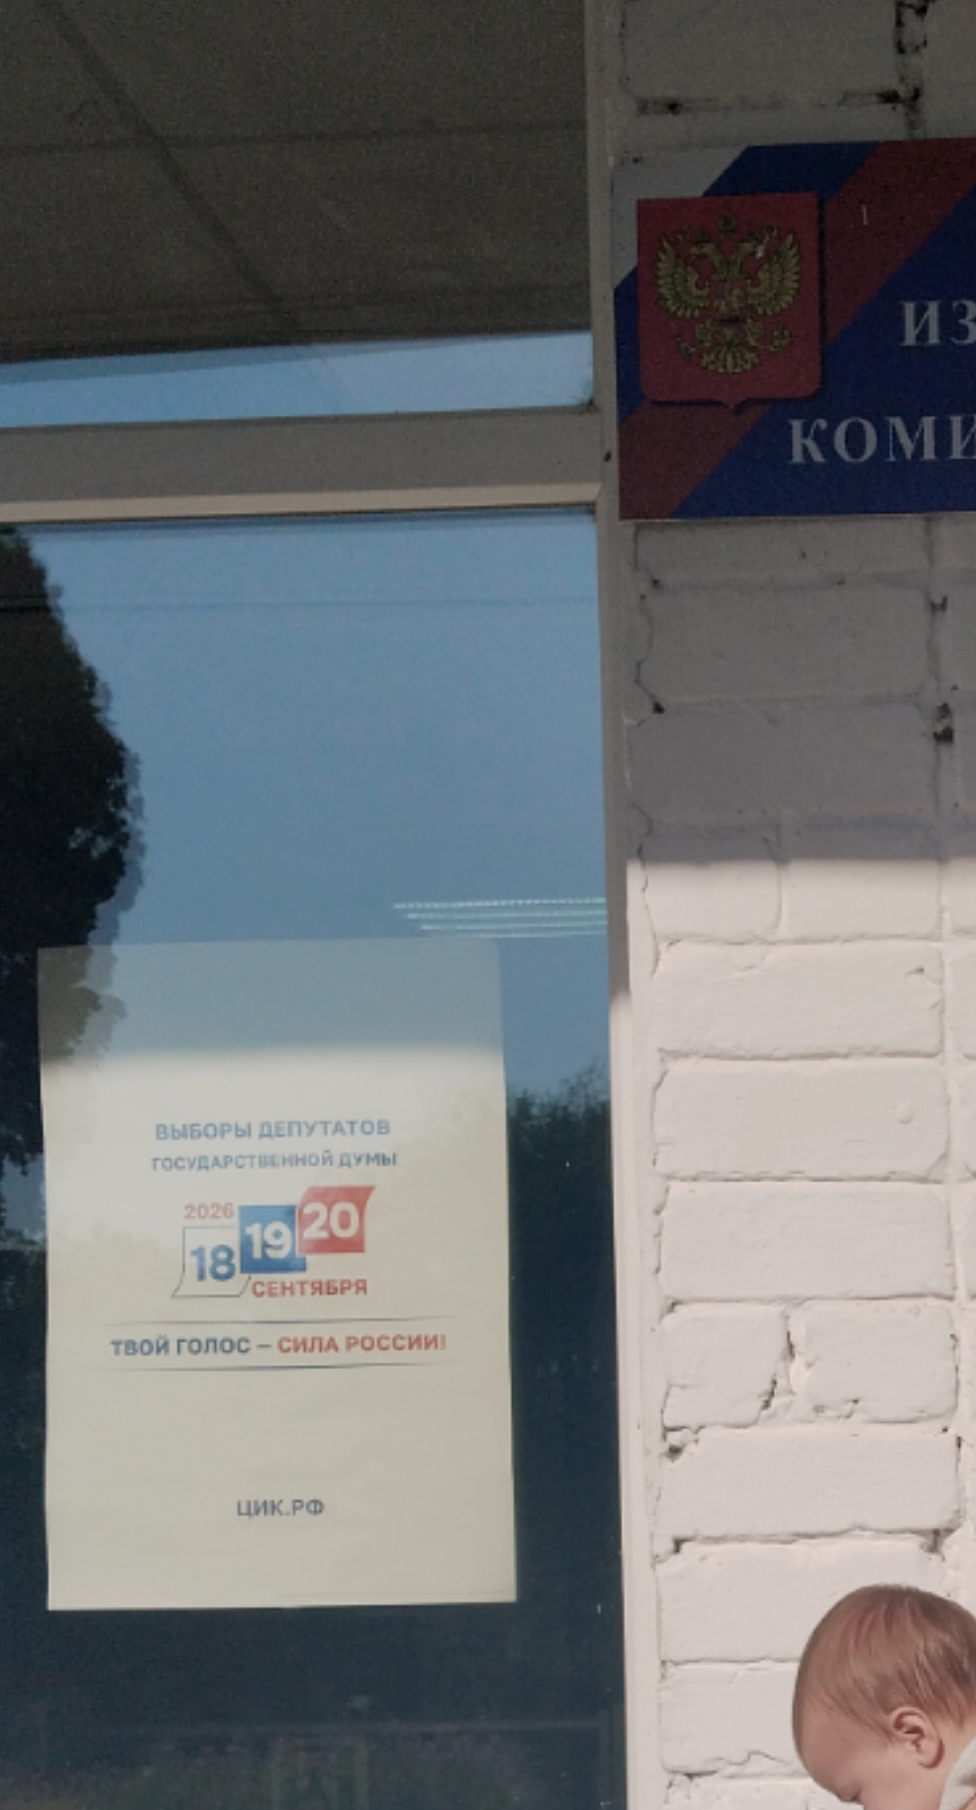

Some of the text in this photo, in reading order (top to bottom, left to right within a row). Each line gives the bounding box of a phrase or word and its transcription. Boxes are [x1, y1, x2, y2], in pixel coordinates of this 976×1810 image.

[155, 1119, 391, 1141] ВЫБОРЫ ДЕПУТАТОВ
[151, 1150, 398, 1172] ГОСУДАРСТВЕННОЙ ДУМЫ
[184, 1202, 235, 1220] 2026
[190, 1201, 360, 1282] 18 19 20
[251, 1278, 368, 1298] СЕНТЯБРЯ
[111, 1334, 170, 1357] ТВОЙ
[176, 1336, 252, 1355] ГОЛОС
[277, 1336, 340, 1354] СИЛА
[345, 1333, 446, 1353] РОССИИ!
[236, 1497, 325, 1520] ЦИК.РФ
